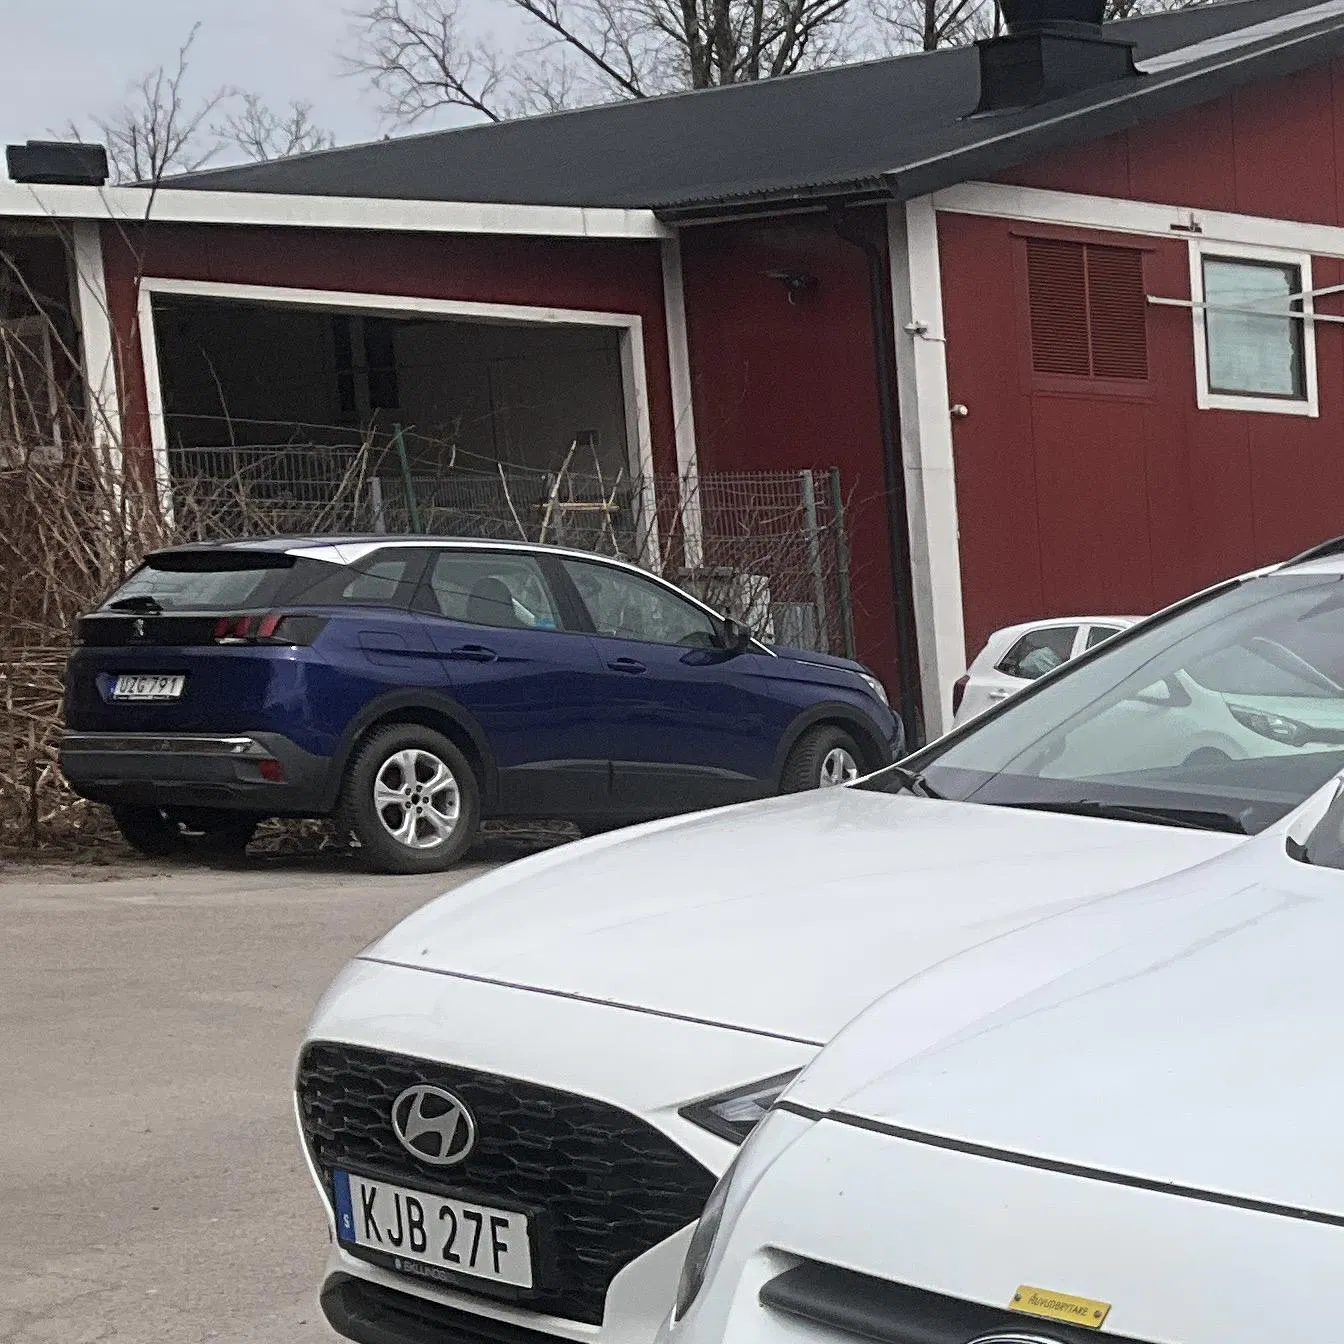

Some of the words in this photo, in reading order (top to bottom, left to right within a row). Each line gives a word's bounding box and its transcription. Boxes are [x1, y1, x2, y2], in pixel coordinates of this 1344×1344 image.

[119, 677, 146, 693] UZG
[149, 677, 178, 693] 791
[343, 1213, 351, 1229] S
[361, 1183, 427, 1253] KJB
[439, 1205, 510, 1274] 27F
